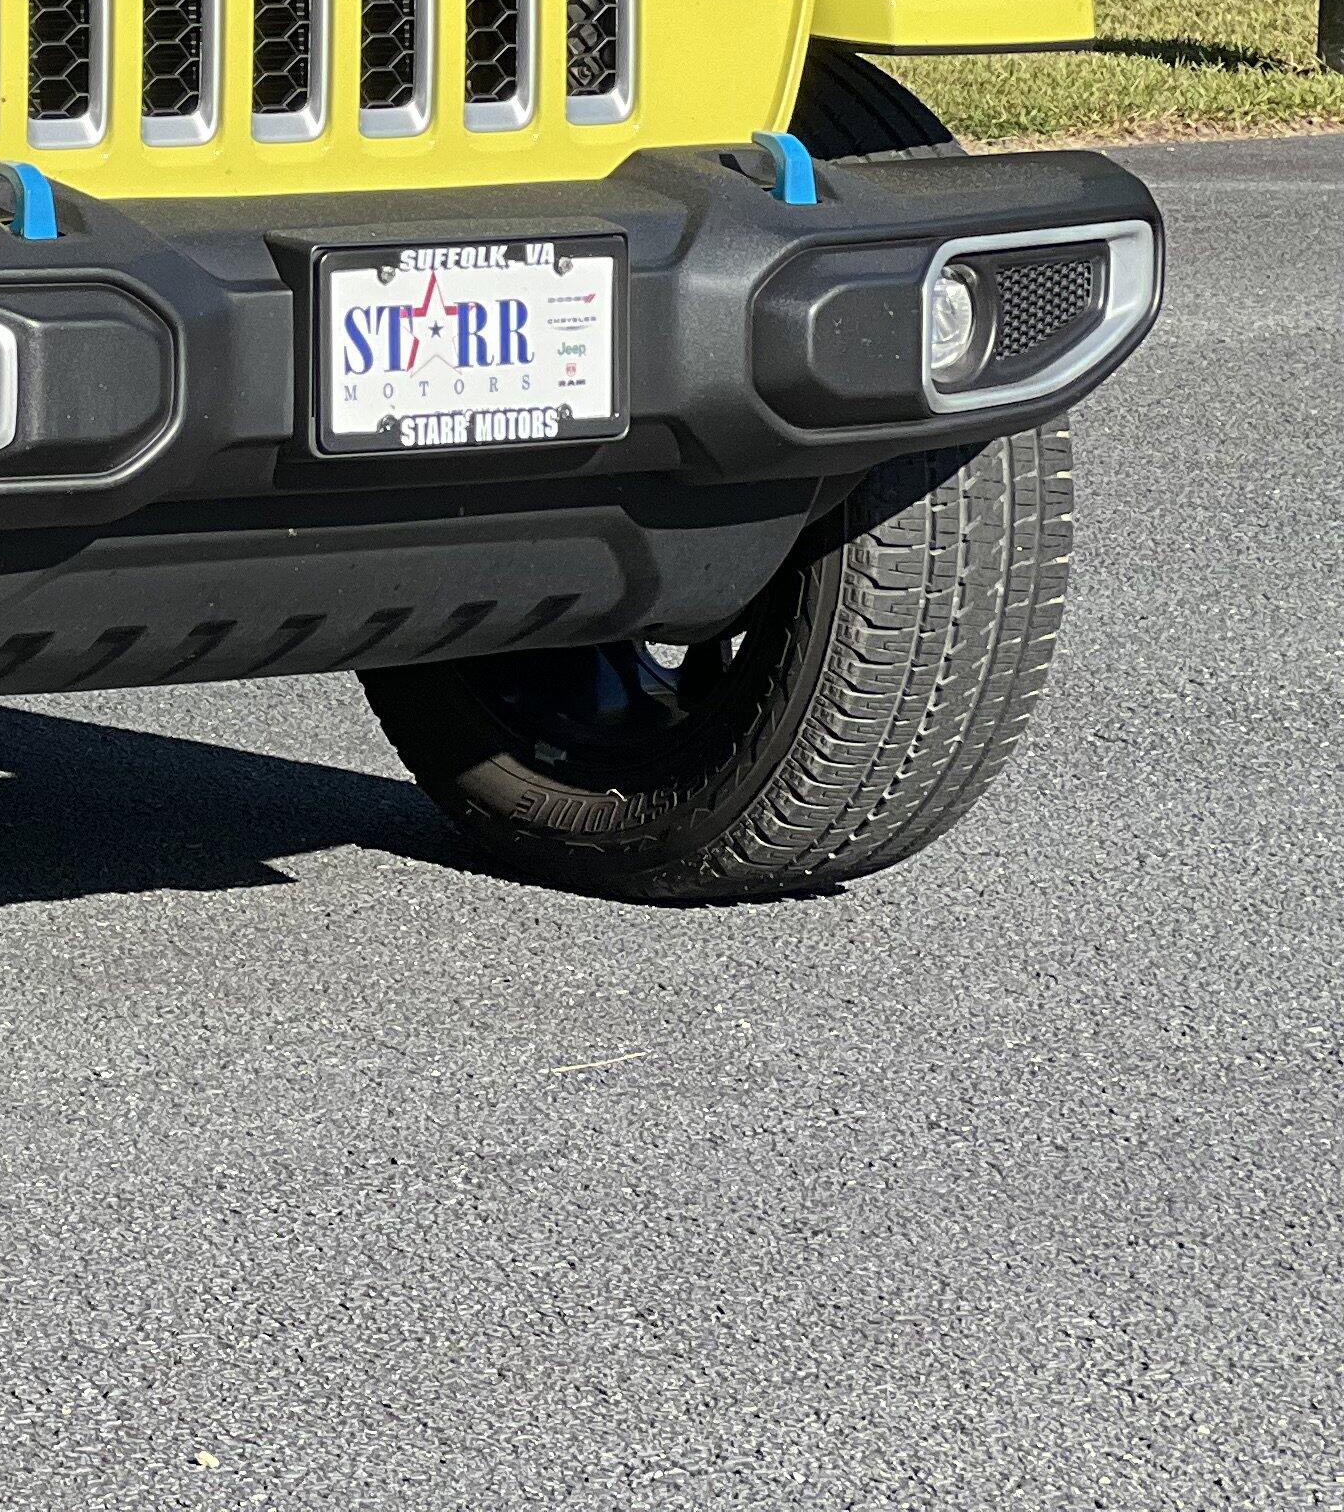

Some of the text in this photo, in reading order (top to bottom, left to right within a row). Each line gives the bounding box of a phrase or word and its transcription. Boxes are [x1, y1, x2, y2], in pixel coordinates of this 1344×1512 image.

[526, 243, 556, 265] VA
[557, 342, 587, 357] Jeep
[344, 374, 531, 402] MOTORS
[558, 379, 586, 387] RAM
[399, 407, 559, 446] STARR MOTORS
